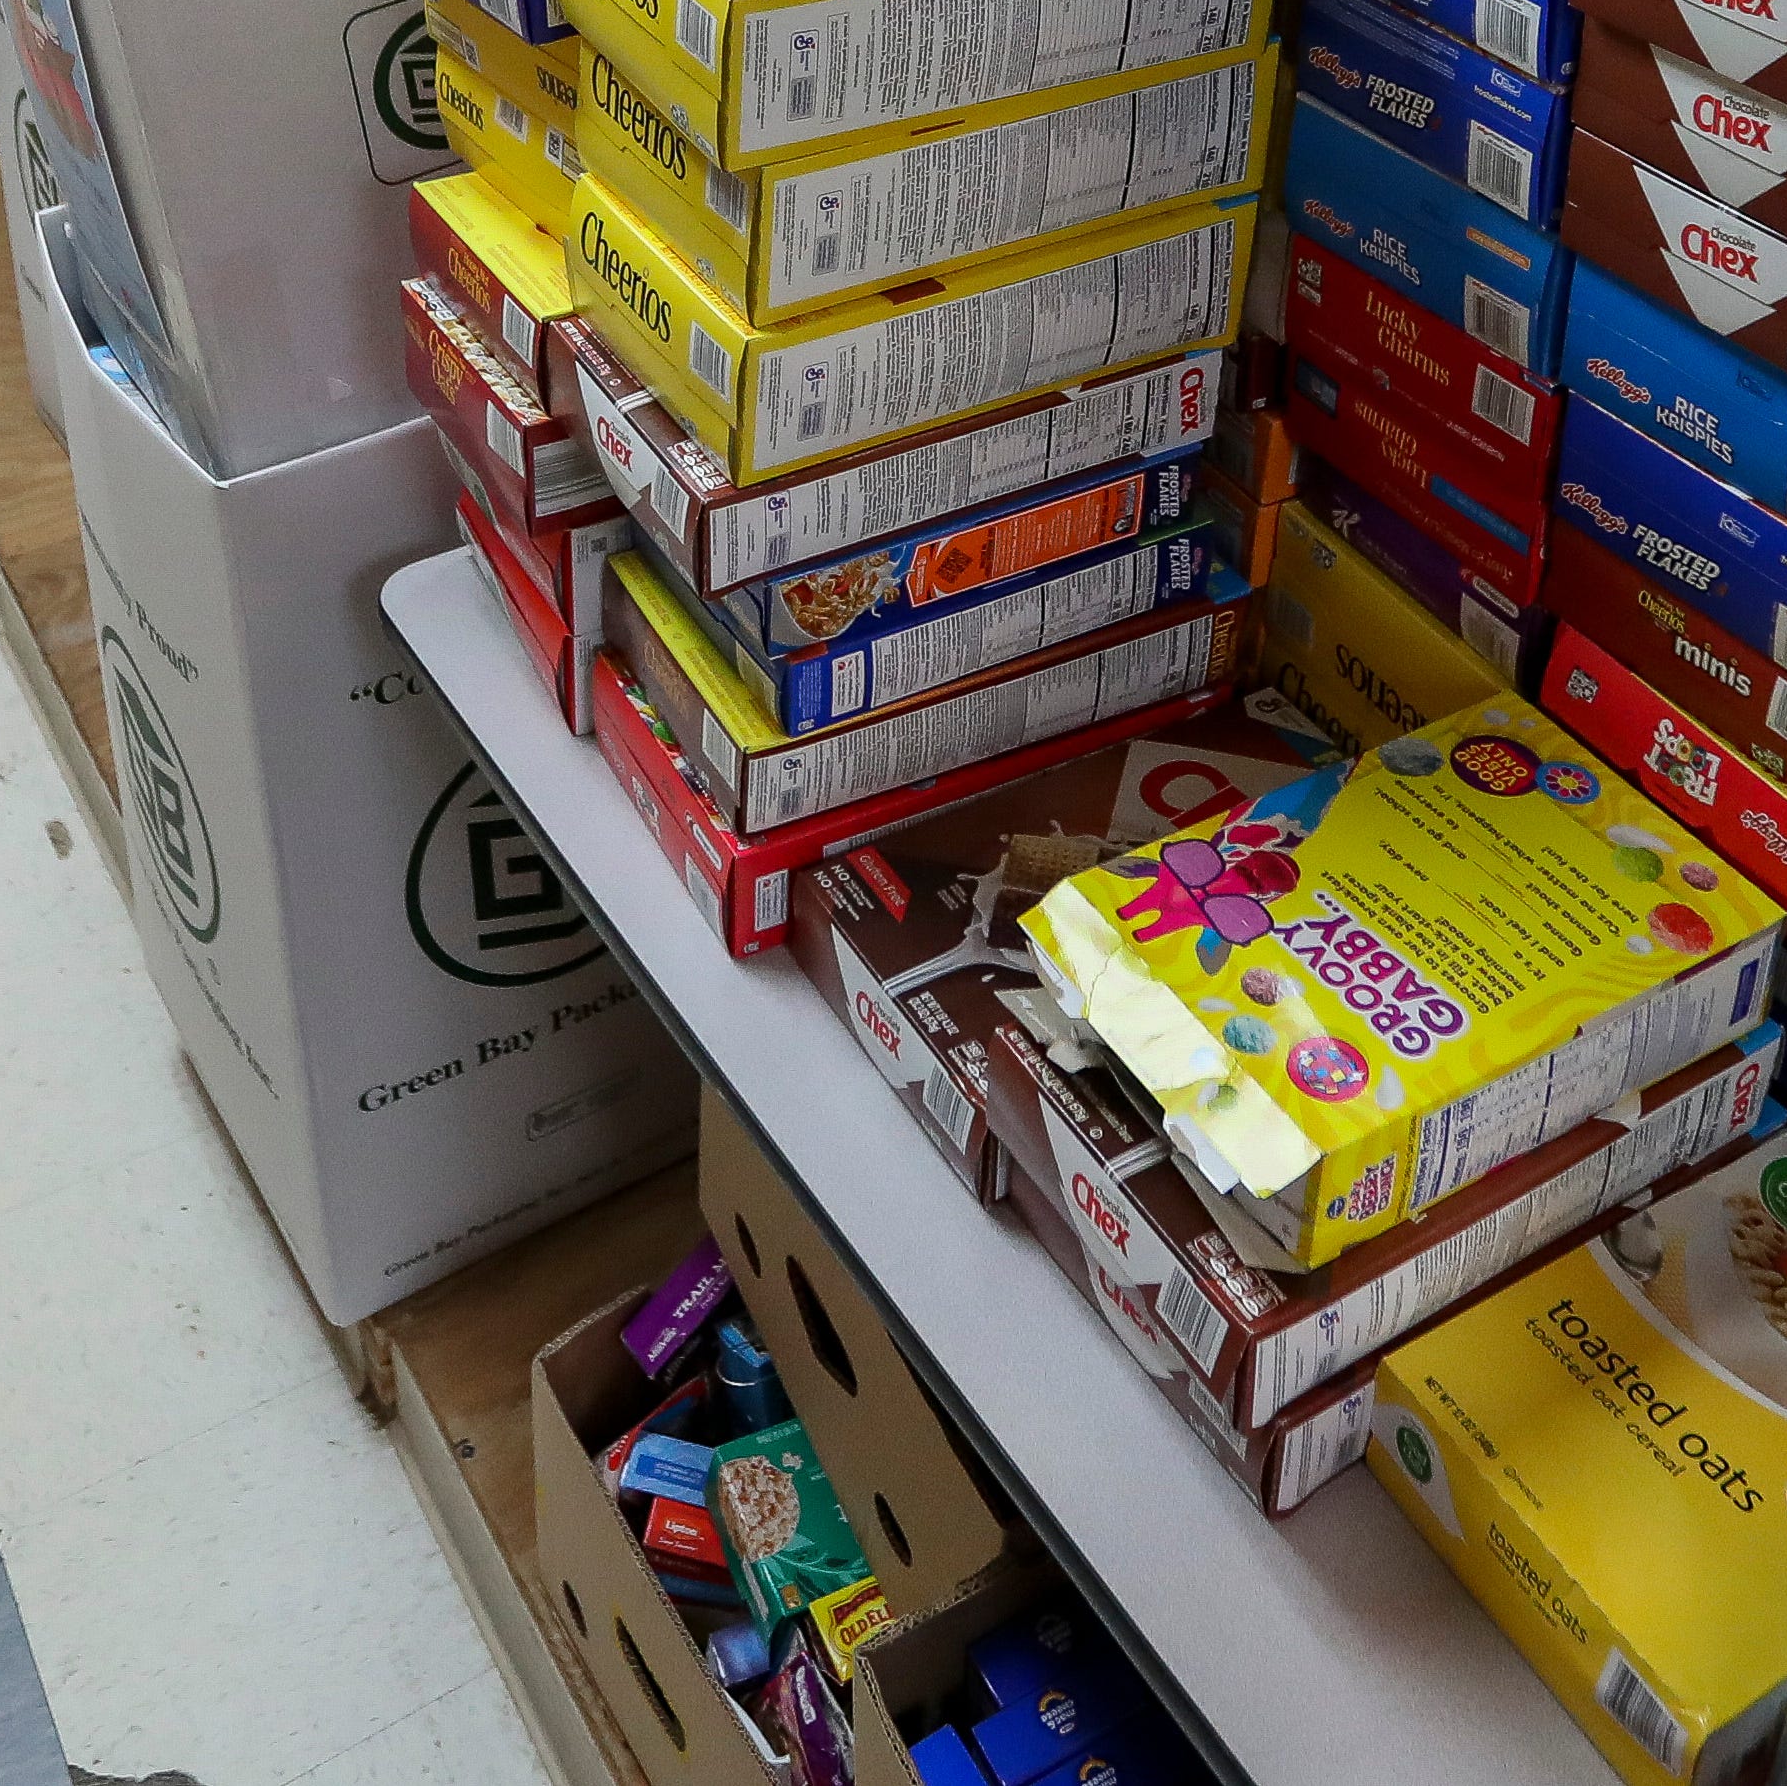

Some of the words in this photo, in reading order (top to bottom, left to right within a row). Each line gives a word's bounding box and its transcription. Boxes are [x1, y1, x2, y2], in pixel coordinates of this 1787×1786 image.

[438, 71, 485, 132] Cheerios
[1309, 46, 1362, 89] Kellogg's
[1365, 73, 1435, 116] FROSTED
[591, 52, 688, 181] Cheerios
[1368, 93, 1429, 131] FLAKES
[1692, 93, 1772, 154] Chex
[1723, 94, 1770, 121] Chocolate
[1360, 239, 1422, 287] KRISPIES
[1372, 227, 1407, 258] RICE
[1680, 223, 1761, 284] Chex
[1710, 227, 1758, 255] Chocolate
[580, 211, 673, 344] Cheerios
[1364, 290, 1422, 341] Lucky
[1377, 323, 1451, 387] Charms
[1179, 366, 1205, 437] Chex
[1587, 358, 1651, 404] Kellogg's
[1675, 395, 1719, 436] RICE
[596, 416, 633, 472] Chex
[1656, 405, 1734, 466] KRISPIES
[1158, 470, 1171, 517] FLAKES
[1168, 465, 1181, 518] FROSTED
[1562, 482, 1629, 536] Kellogg's
[1633, 523, 1722, 580] FROSTED
[1168, 544, 1182, 590] FLAKES
[1178, 538, 1192, 591] FROSTED
[1636, 543, 1711, 593] FLAKES
[1674, 634, 1753, 698] minis
[1454, 750, 1505, 792] GOOD
[1467, 744, 1518, 788] VIBES
[1480, 741, 1529, 779] ONLY
[1654, 717, 1722, 782] LOOPS
[1643, 742, 1719, 806] FROOT
[1395, 779, 1446, 819] everyone
[830, 864, 850, 882] NO
[1403, 862, 1429, 882] new
[1441, 842, 1468, 861] and
[1503, 838, 1536, 865] what
[813, 871, 834, 890] NO
[858, 853, 888, 885] Gluten
[884, 882, 907, 908] Free
[1321, 870, 1377, 919] breakfast
[1342, 873, 1381, 904] spaces
[1373, 882, 1403, 906] your
[1525, 882, 1561, 912] shout
[1536, 864, 1579, 901] matter
[1568, 866, 1590, 885] the
[1589, 883, 1611, 901] for
[1378, 918, 1404, 939] own
[1382, 904, 1415, 932] blank
[1406, 907, 1461, 953] kick-start
[1434, 915, 1475, 949] mood!
[1506, 918, 1533, 941] feel
[1562, 911, 1602, 947] Gonna
[1611, 900, 1640, 924] here
[1404, 938, 1425, 958] her
[1415, 931, 1435, 949] the
[1538, 945, 1565, 968] and
[1542, 921, 1583, 958] Gonna
[1273, 923, 1432, 1056] GROOVY
[1440, 968, 1490, 1014] Grooves
[1471, 975, 1503, 1008] beat.
[1475, 946, 1526, 992] morning
[1477, 965, 1514, 999] below
[855, 991, 902, 1062] Chex
[357, 1052, 464, 1120] Green
[475, 1021, 542, 1077] Bay
[1727, 1062, 1758, 1132] Chex
[1071, 1171, 1131, 1259] Chex
[672, 1274, 712, 1320] TRAIL
[1525, 1317, 1594, 1388] toasted
[1592, 1387, 1627, 1421] oat
[1626, 1422, 1686, 1478] cereal
[1547, 1298, 1689, 1429] toasted
[1678, 1431, 1765, 1515] oats
[664, 1518, 699, 1537] Lipton
[1489, 1520, 1553, 1598] toasted
[1551, 1594, 1589, 1645] oats
[839, 1619, 869, 1647] OLD
